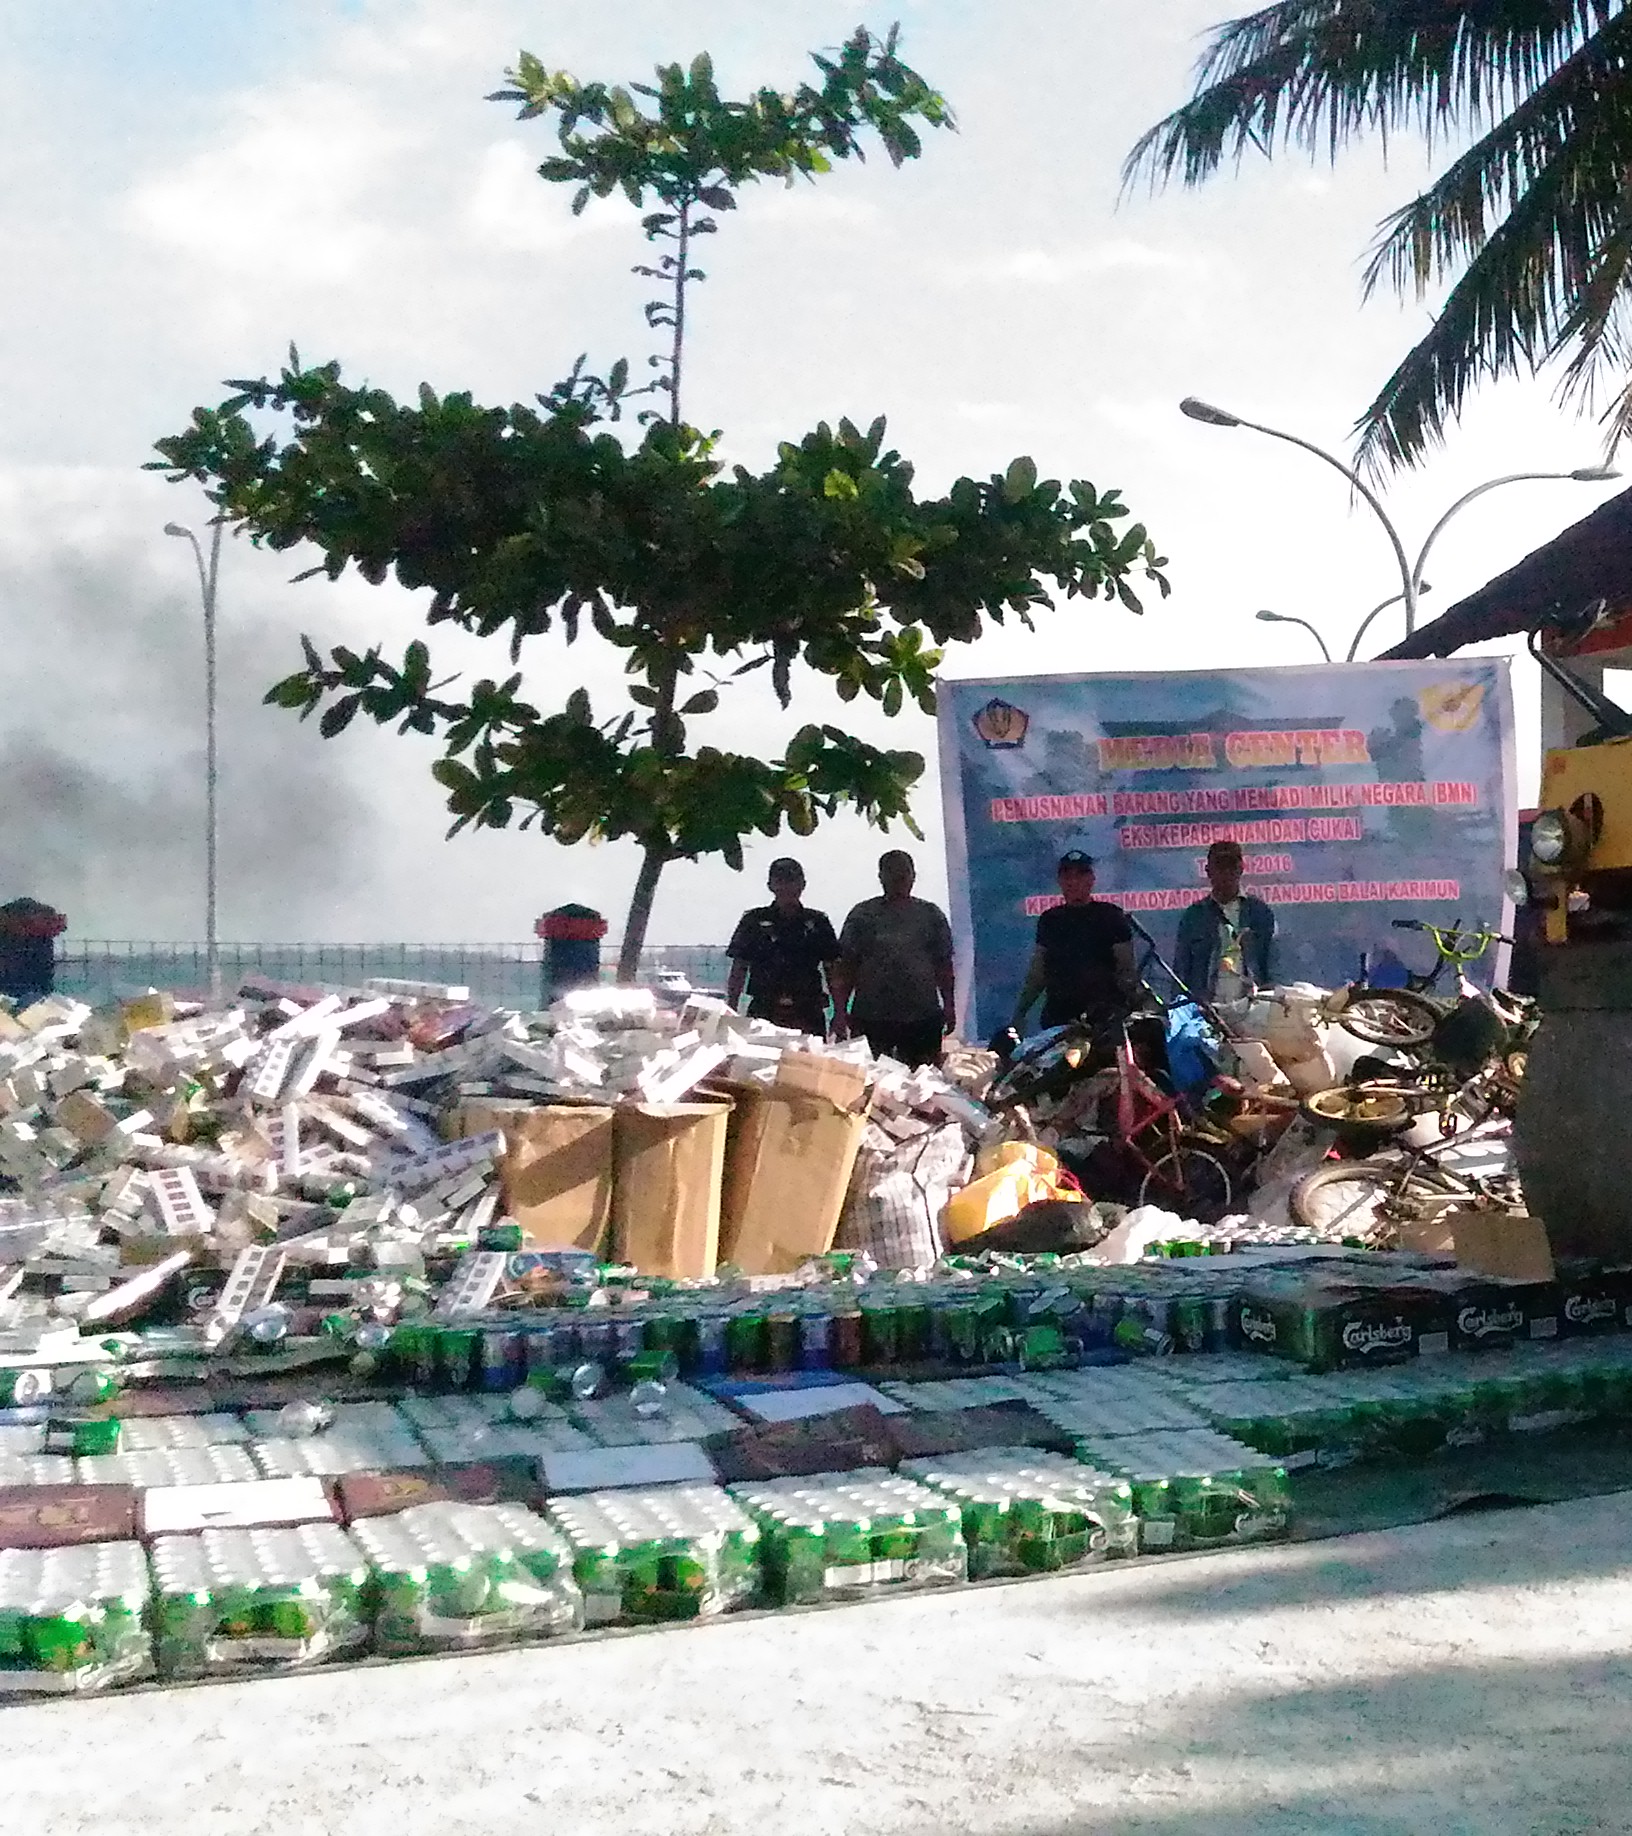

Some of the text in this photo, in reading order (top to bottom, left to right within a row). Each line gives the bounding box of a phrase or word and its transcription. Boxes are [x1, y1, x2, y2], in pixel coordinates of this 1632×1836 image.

[1226, 729, 1371, 767] CENTER
[1113, 792, 1180, 815] BARANG
[1185, 790, 1229, 812] YANG
[1233, 786, 1305, 810] MENJADI
[1309, 784, 1356, 808] MILIK
[1361, 783, 1426, 806] NEGARA
[1432, 782, 1478, 806] (BMN)
[1272, 819, 1305, 842] DAN
[1309, 817, 1361, 841] CUKAI
[1255, 855, 1292, 873] 2016
[1125, 891, 1177, 910] MADYA
[1263, 883, 1334, 902] TANJUNG
[1339, 881, 1383, 900] BALAI
[1388, 880, 1460, 900] KARIMUN
[1343, 1316, 1412, 1354] Carlsberg
[1457, 1303, 1523, 1338] Carlsberg
